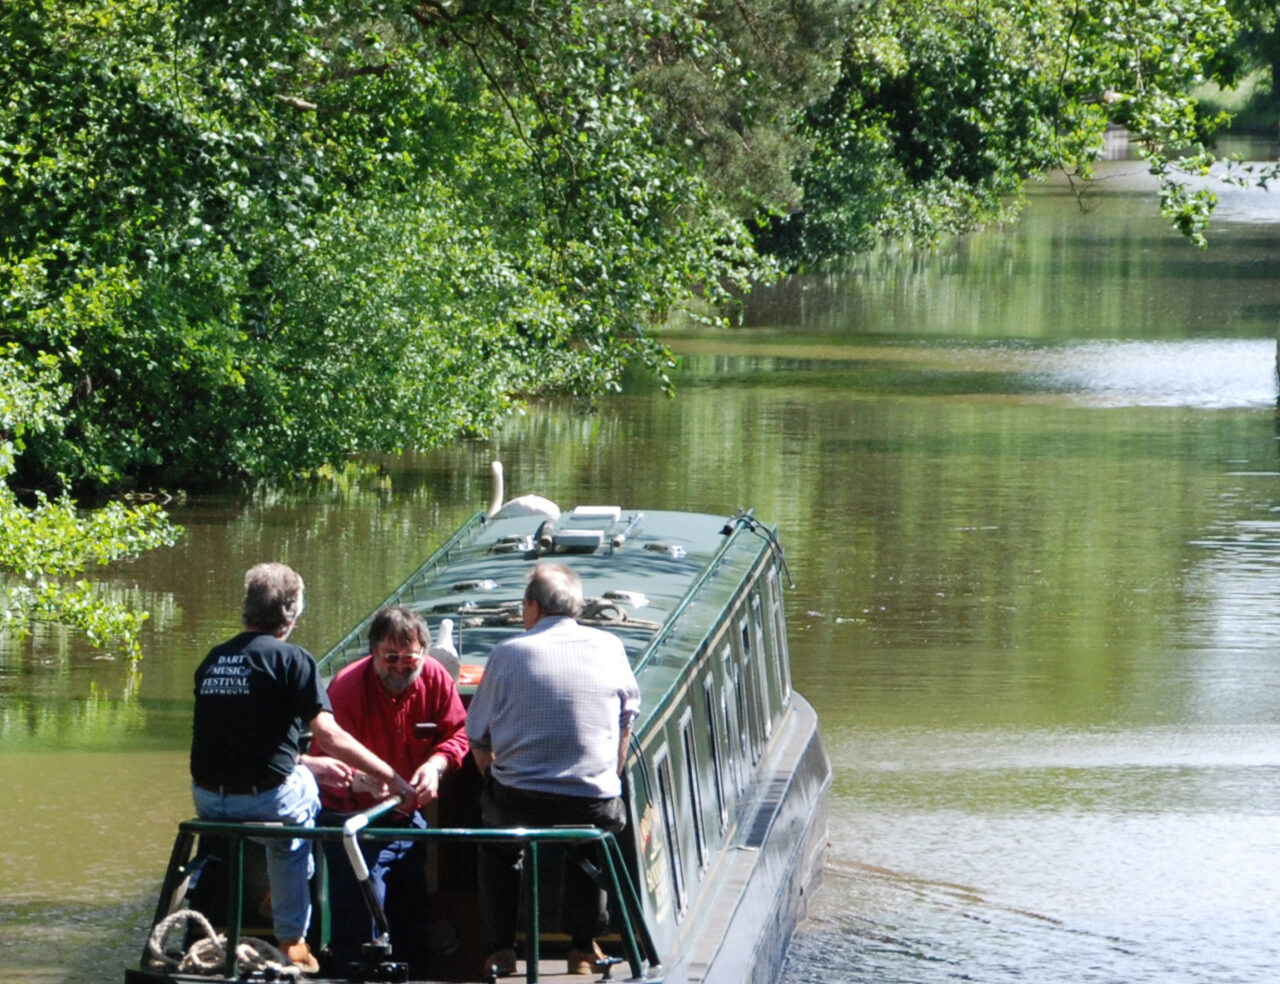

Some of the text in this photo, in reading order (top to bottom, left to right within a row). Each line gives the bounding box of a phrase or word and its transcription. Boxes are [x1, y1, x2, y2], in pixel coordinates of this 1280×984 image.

[218, 655, 245, 664] DART
[212, 666, 245, 676] MUSIC
[202, 677, 249, 687] FESTIVAL
